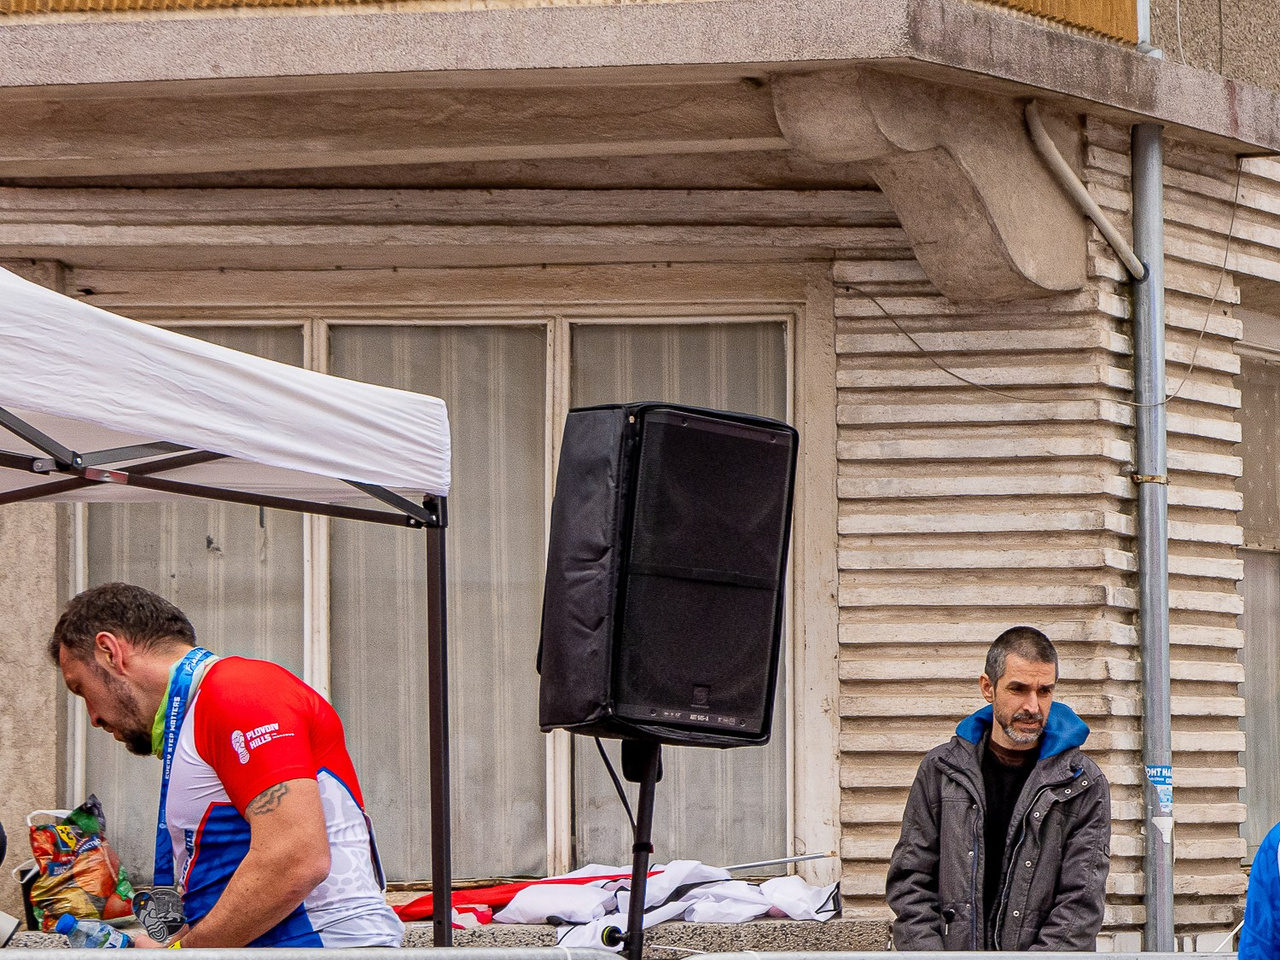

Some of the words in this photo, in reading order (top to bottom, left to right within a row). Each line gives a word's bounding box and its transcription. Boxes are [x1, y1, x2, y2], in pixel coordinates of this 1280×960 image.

[170, 696, 181, 730] MATTERS
[245, 723, 280, 741] PLOVDIV
[248, 733, 273, 750] HILLS
